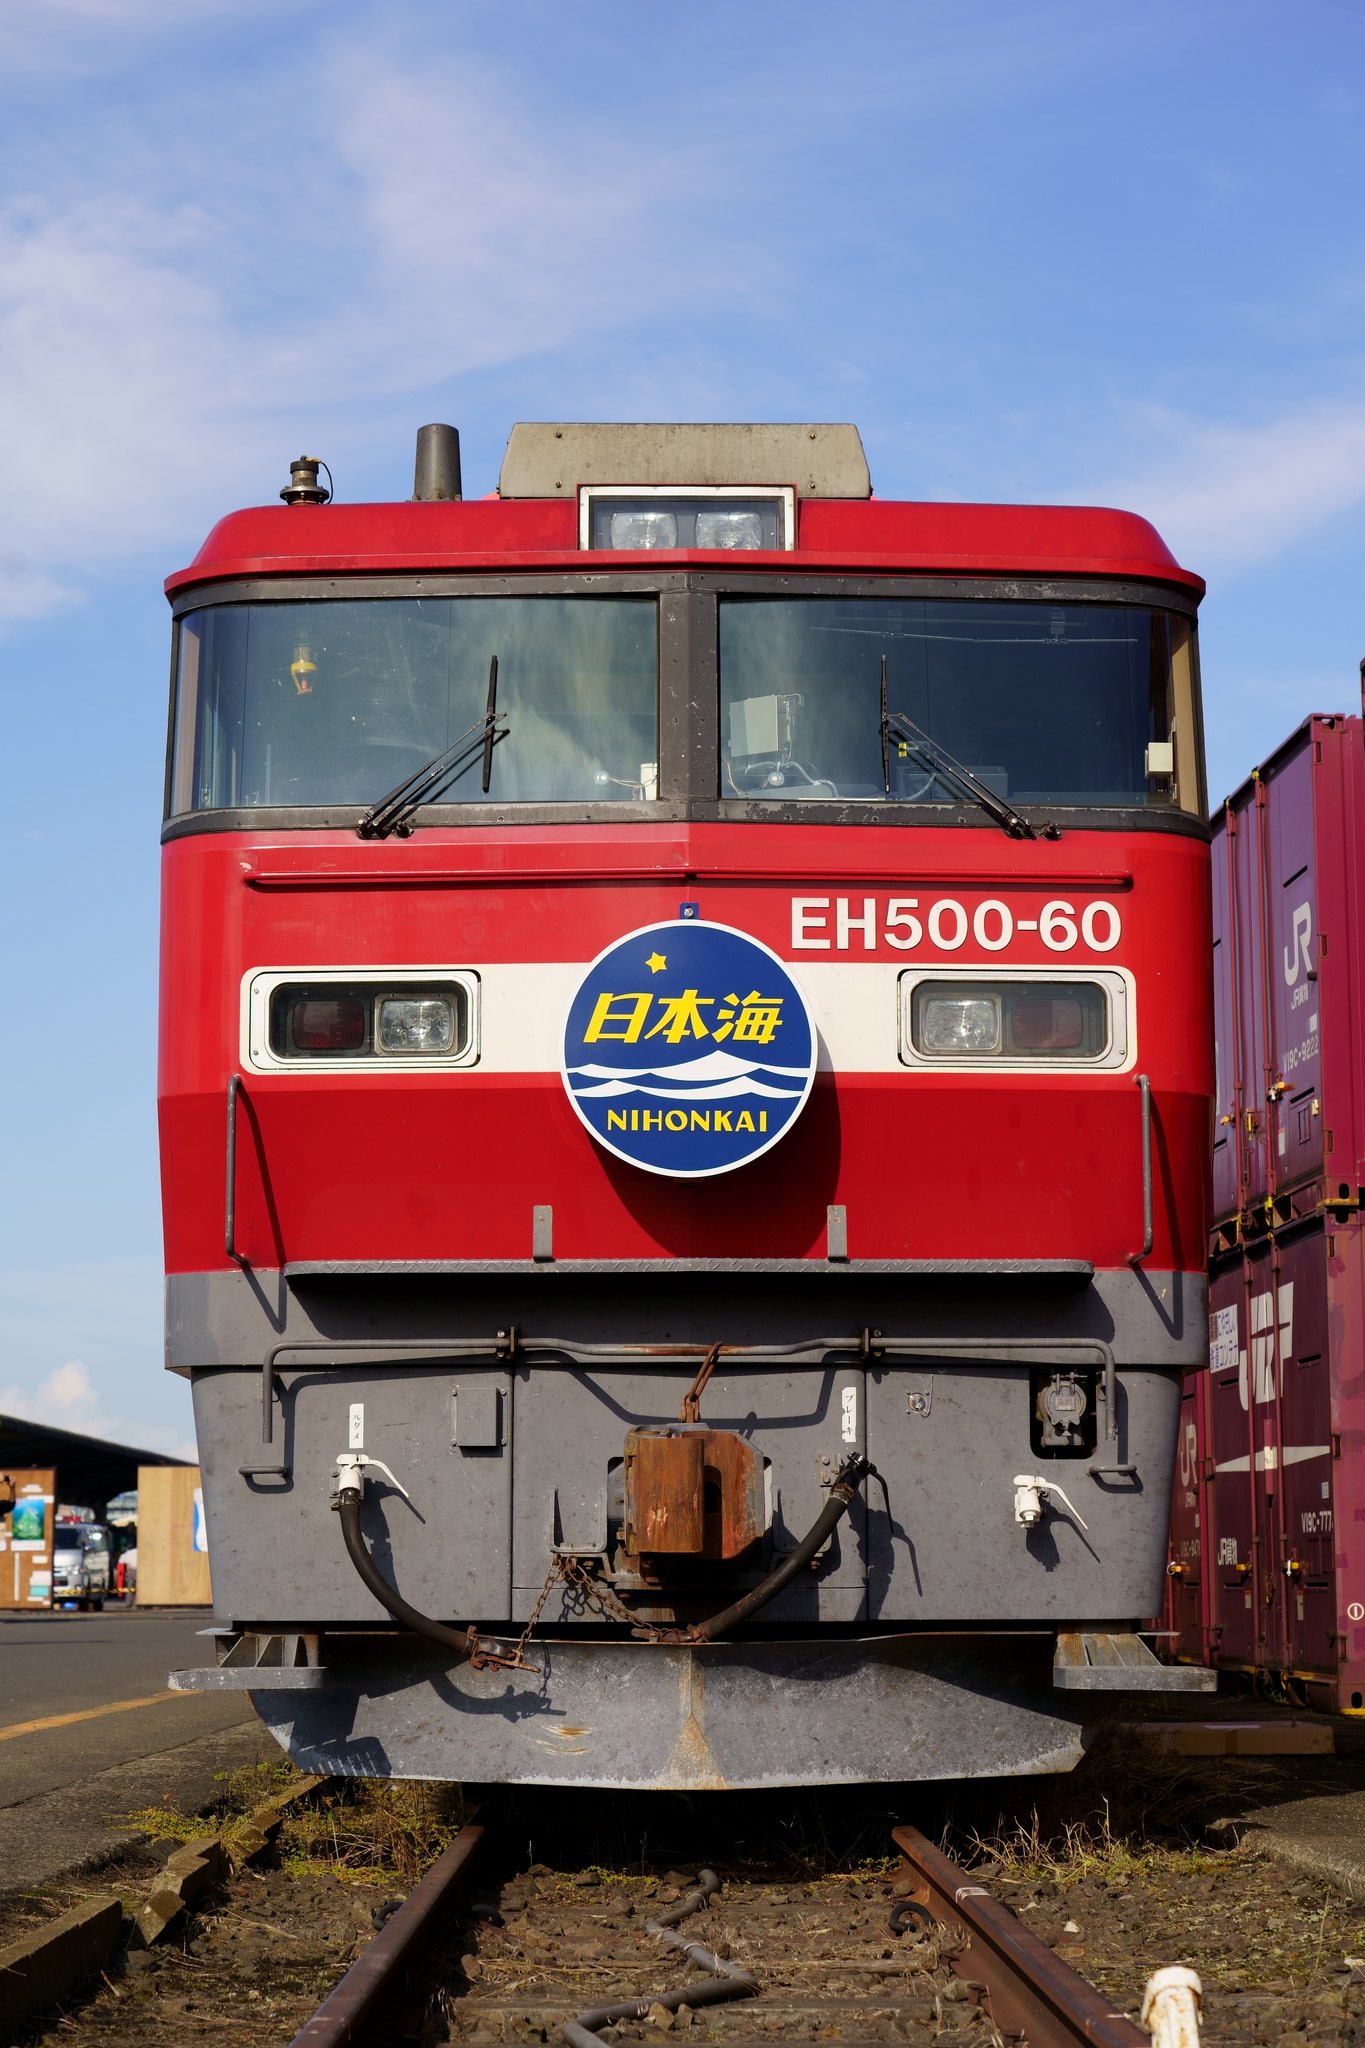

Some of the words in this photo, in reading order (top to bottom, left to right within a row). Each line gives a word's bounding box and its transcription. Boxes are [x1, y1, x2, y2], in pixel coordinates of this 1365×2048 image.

[790, 897, 1122, 952] EH500-60
[583, 989, 784, 1045] 日本海
[606, 1109, 768, 1133] NIHONKAI
